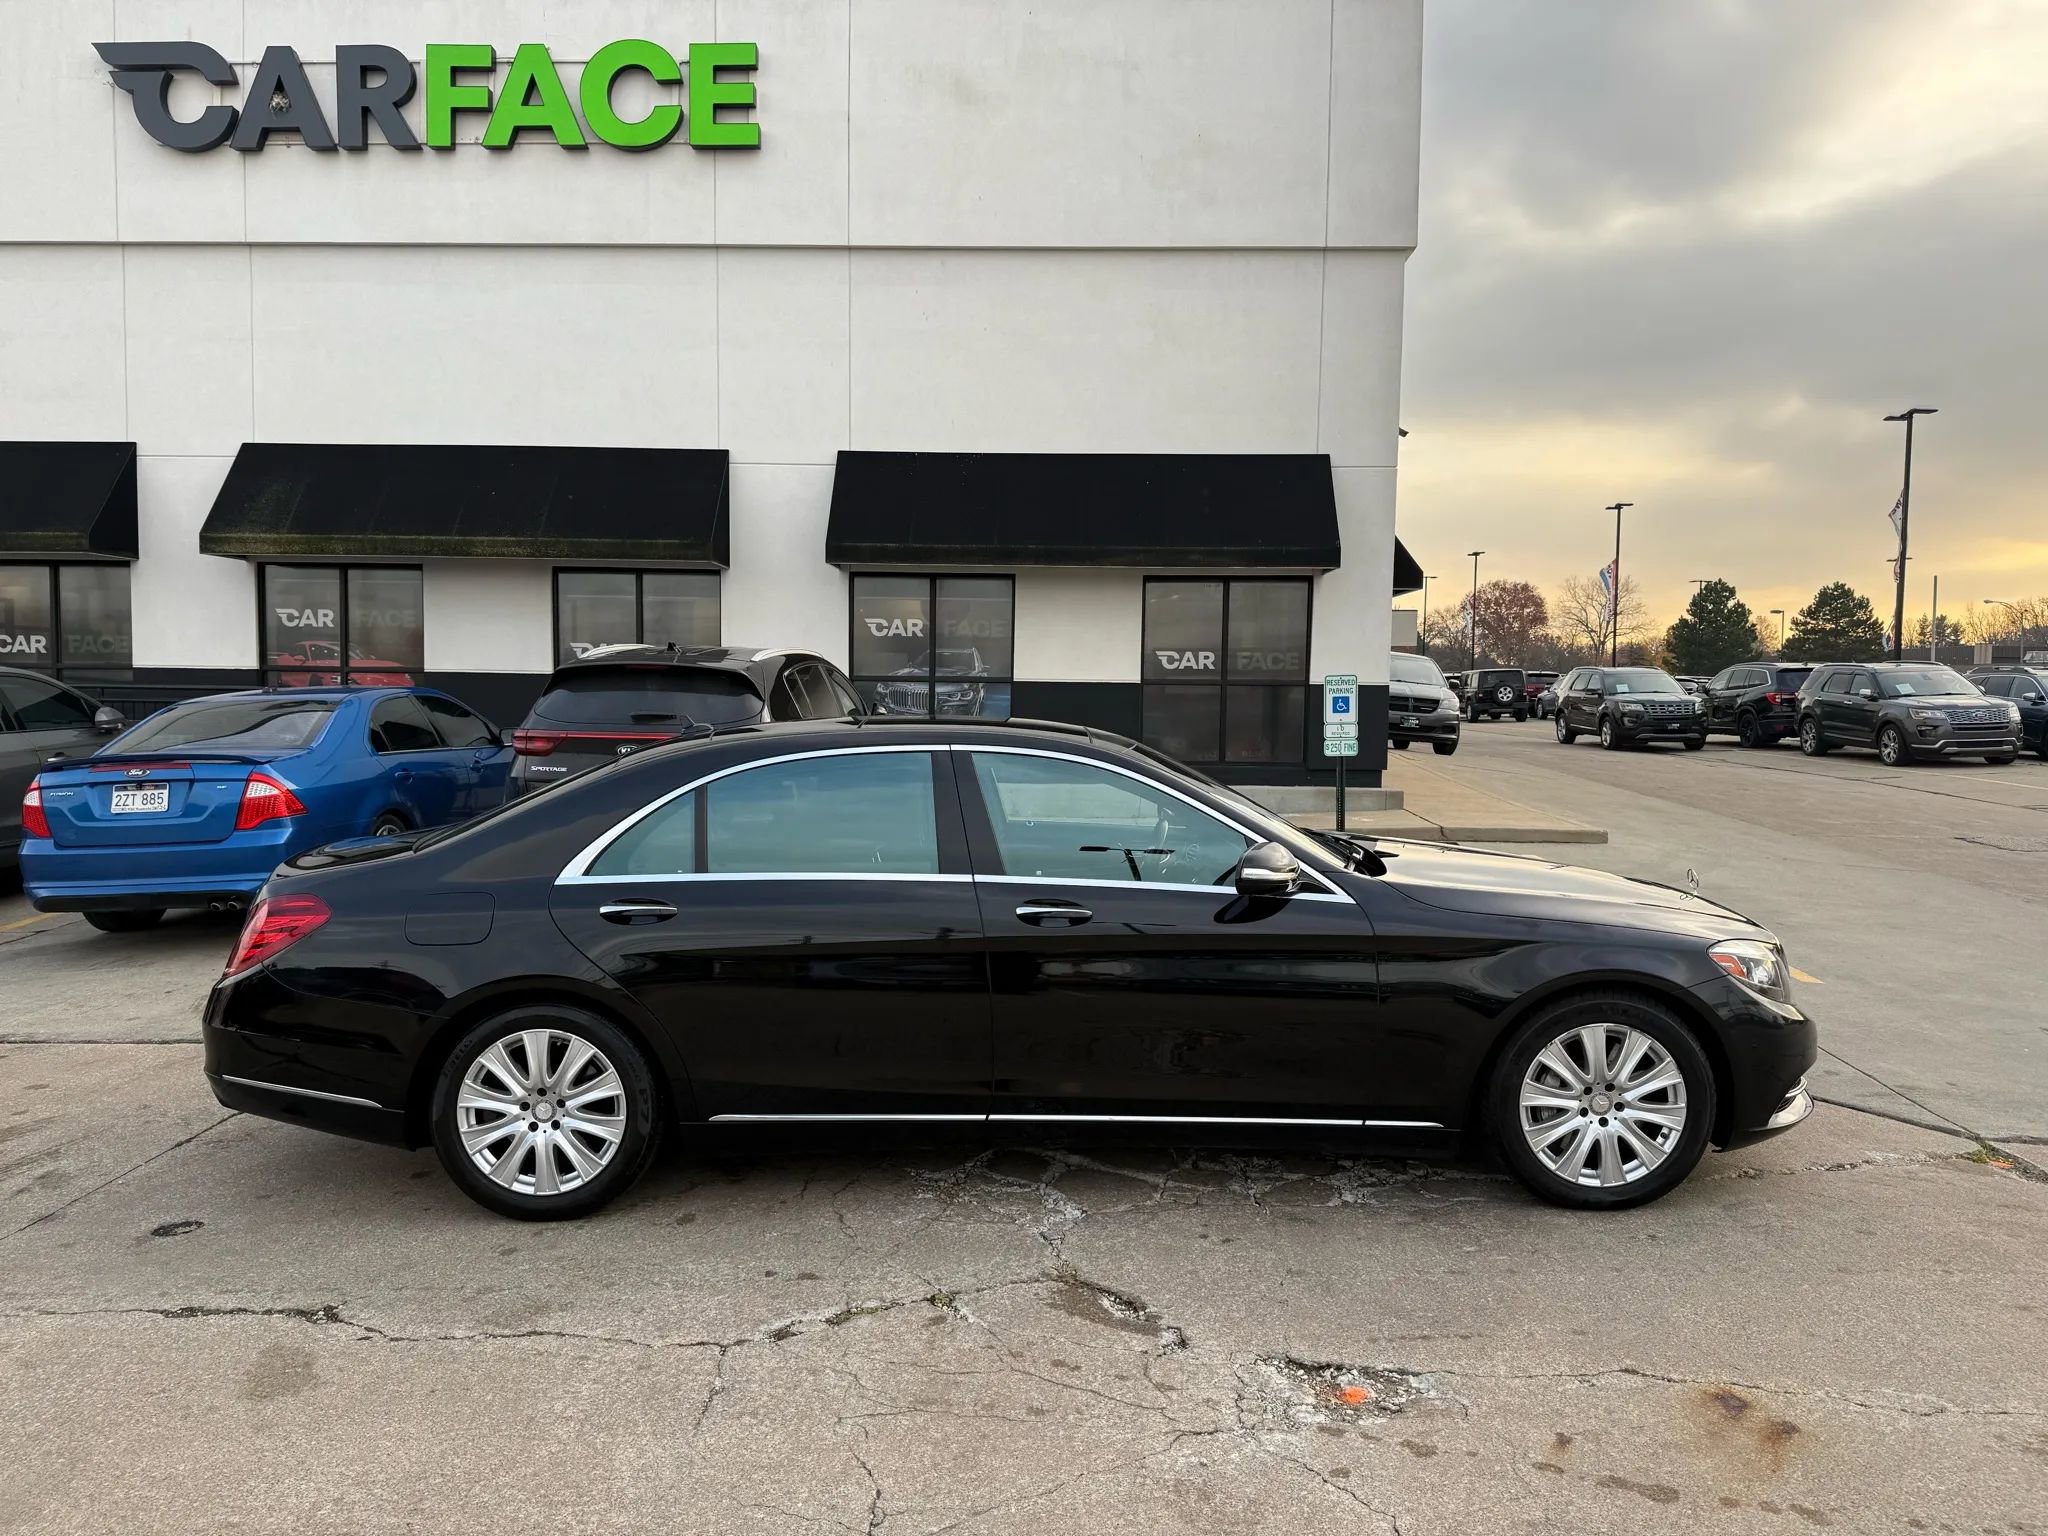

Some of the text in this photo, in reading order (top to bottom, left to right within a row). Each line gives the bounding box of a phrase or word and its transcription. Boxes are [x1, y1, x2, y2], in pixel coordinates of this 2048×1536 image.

[275, 608, 335, 628] CAR
[864, 618, 924, 637] CAR
[0, 634, 129, 654] CAR FACE
[1155, 651, 1299, 670] CAR FACE
[1326, 679, 1356, 687] RESERVED
[1343, 742, 1357, 752] FINE
[114, 792, 164, 807] 2ZT 885
